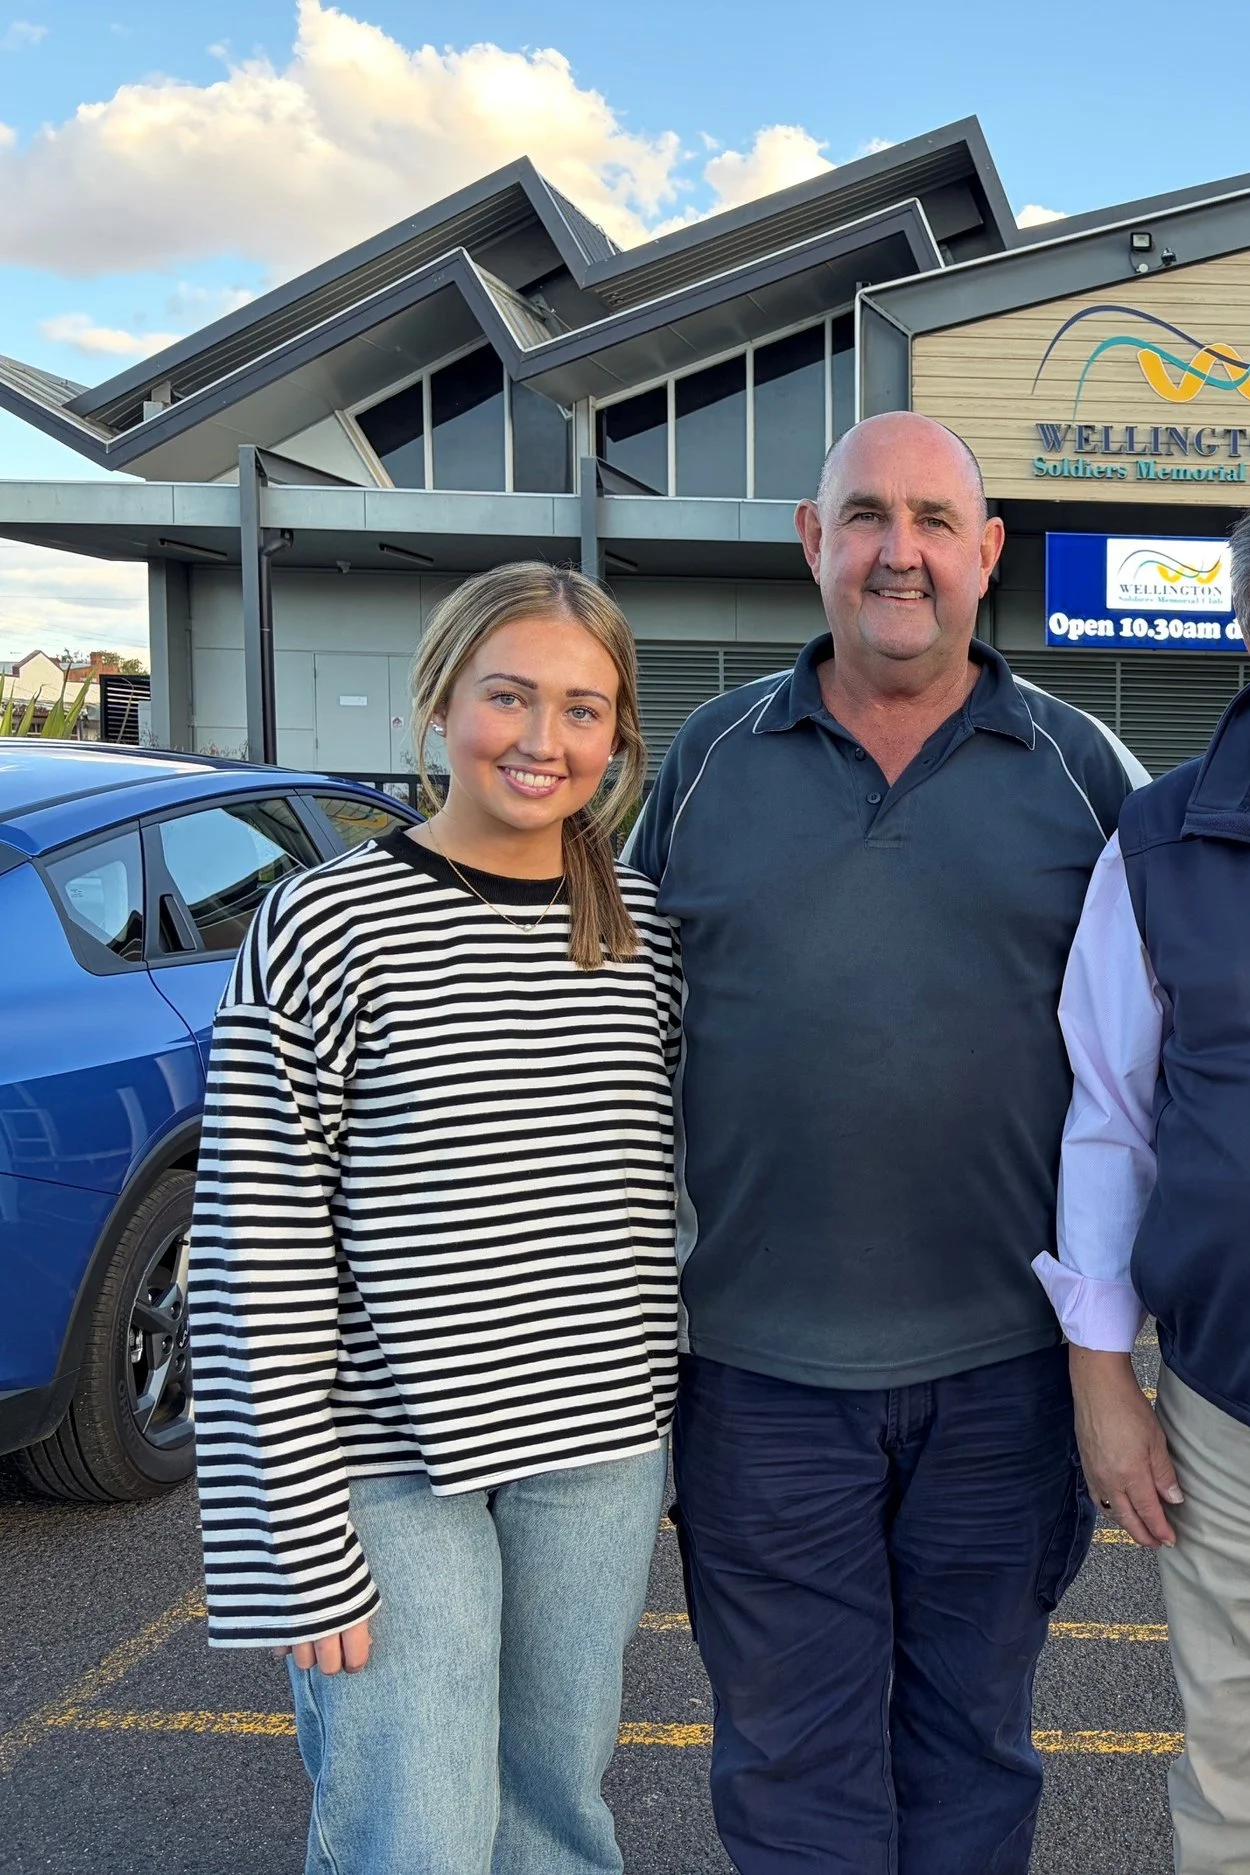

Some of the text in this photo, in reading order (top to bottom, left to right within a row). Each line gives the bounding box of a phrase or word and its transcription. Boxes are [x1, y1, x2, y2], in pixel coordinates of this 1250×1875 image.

[1033, 456, 1129, 480] Soldiers
[1136, 459, 1246, 483] Memorial
[1119, 583, 1223, 597] WELLINGTON
[1049, 612, 1115, 640] Open
[1119, 617, 1222, 641] 10.30am
